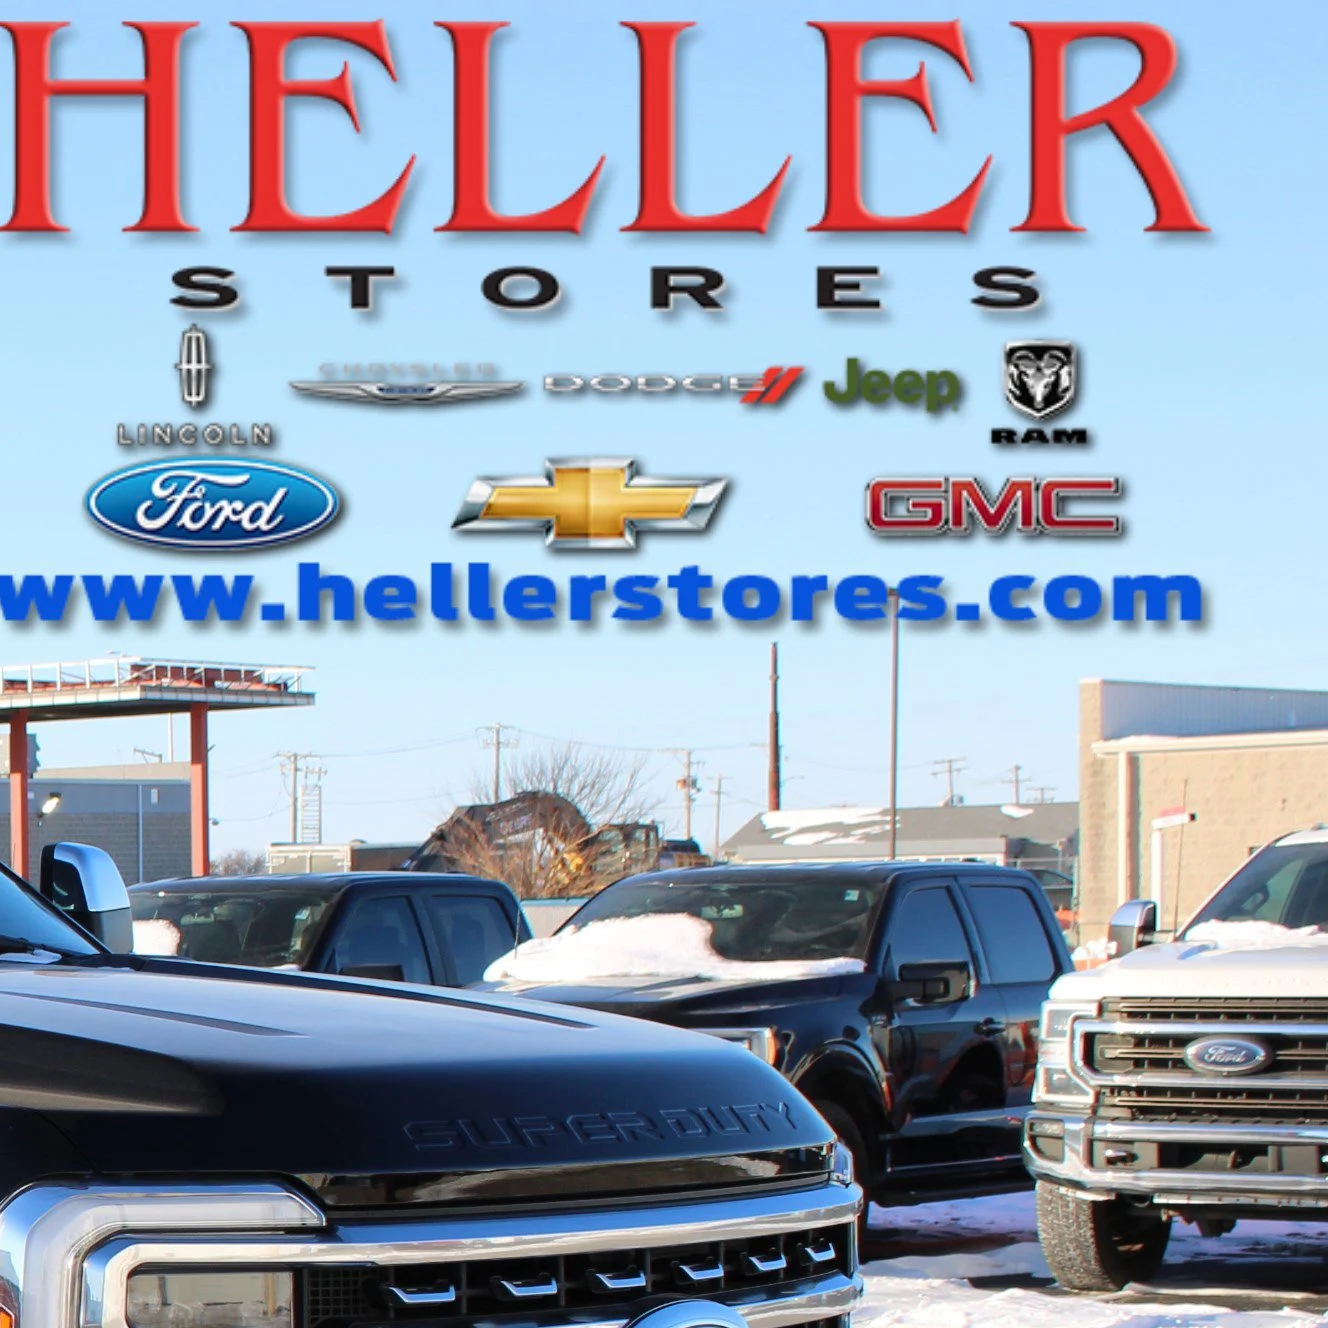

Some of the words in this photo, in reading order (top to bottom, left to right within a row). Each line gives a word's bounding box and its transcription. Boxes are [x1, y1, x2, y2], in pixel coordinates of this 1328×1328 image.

[1205, 1046, 1247, 1063] Ford
[403, 1111, 665, 1152] SUPER
[659, 1101, 797, 1138] DUTY
